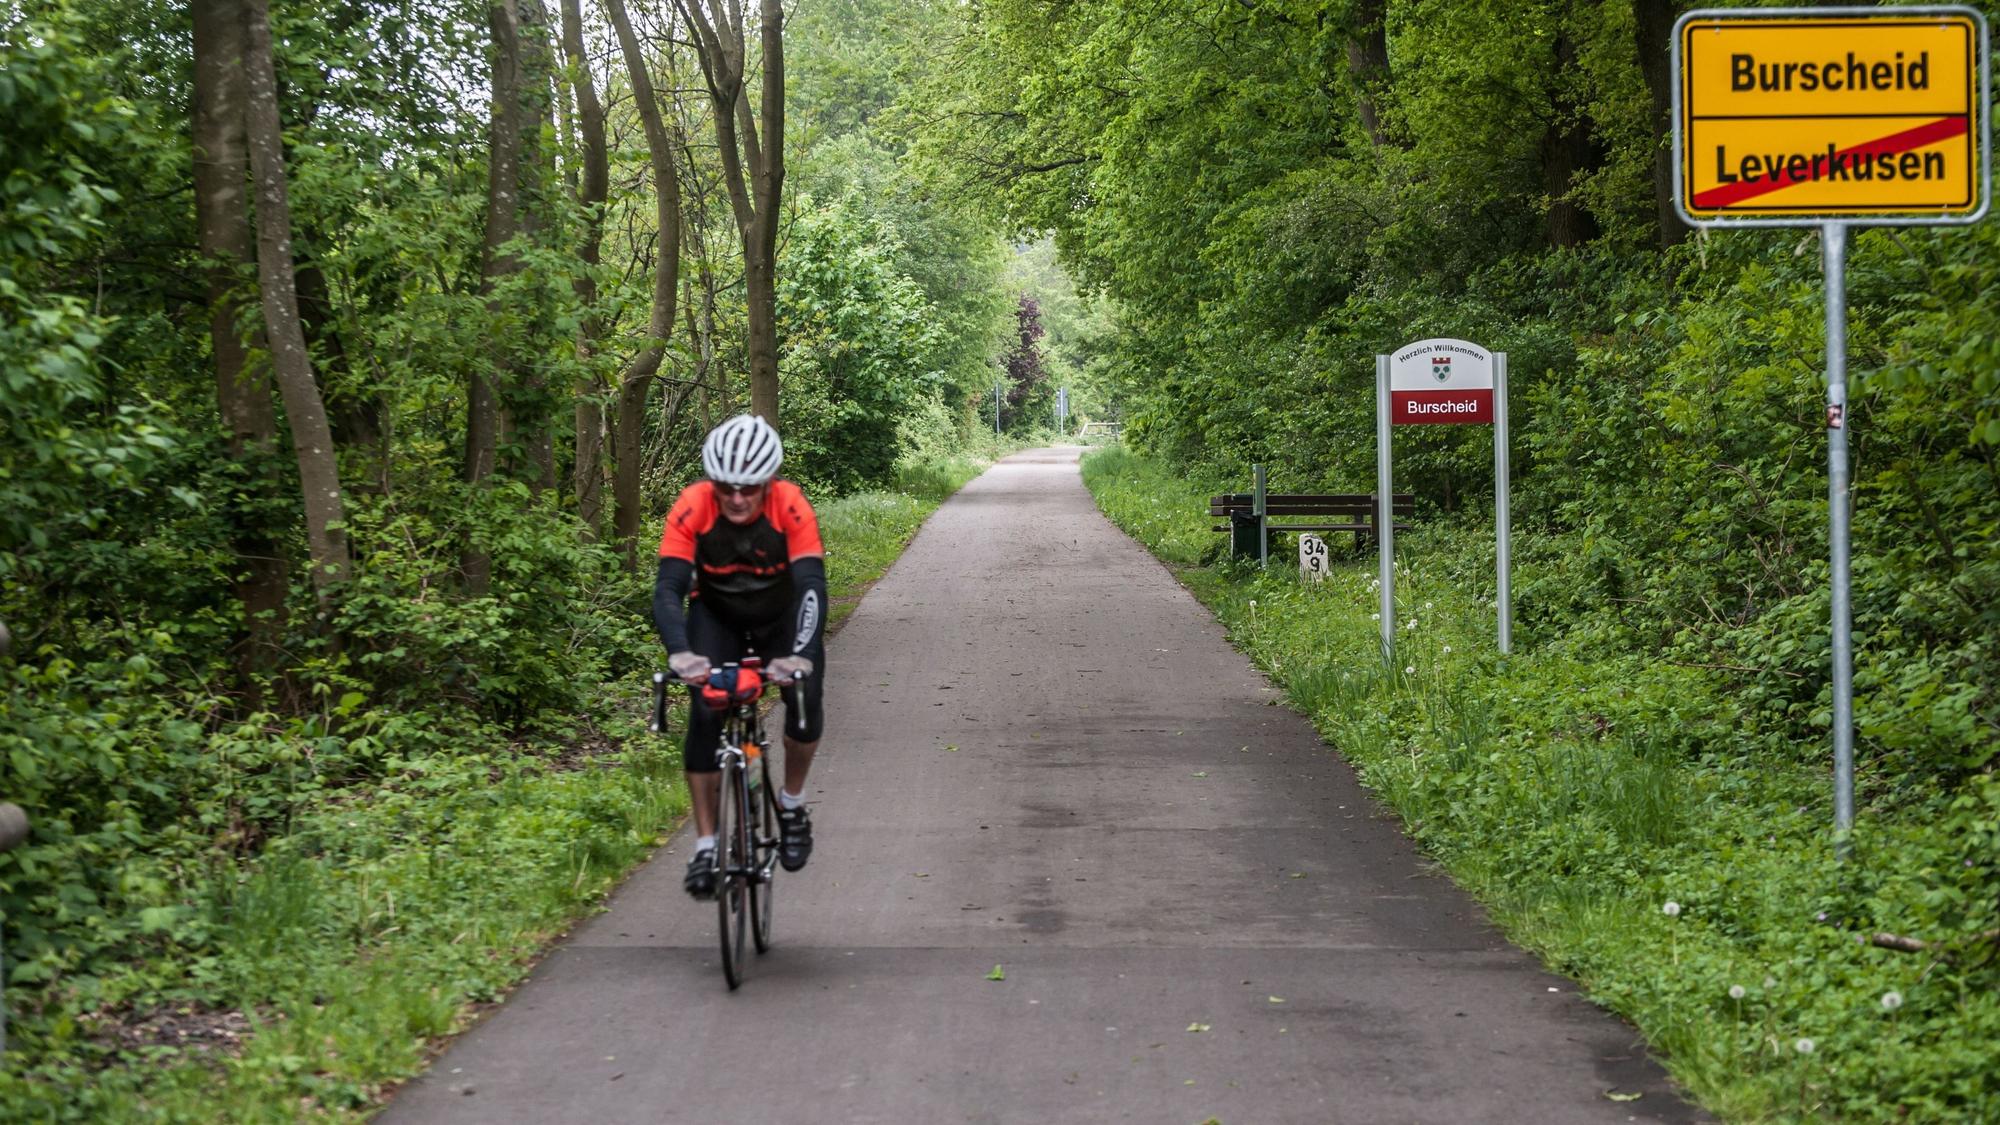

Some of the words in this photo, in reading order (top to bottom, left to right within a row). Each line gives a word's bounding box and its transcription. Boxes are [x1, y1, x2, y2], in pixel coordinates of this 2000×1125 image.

[1731, 51, 1929, 92] Burscheid
[1716, 143, 1946, 184] Leverkusen
[1399, 345, 1433, 363] Herzlich
[1434, 344, 1484, 361] Willkommen
[1407, 400, 1477, 414] Burscheid
[1303, 538, 1325, 556] 34
[1310, 556, 1320, 572] 9
